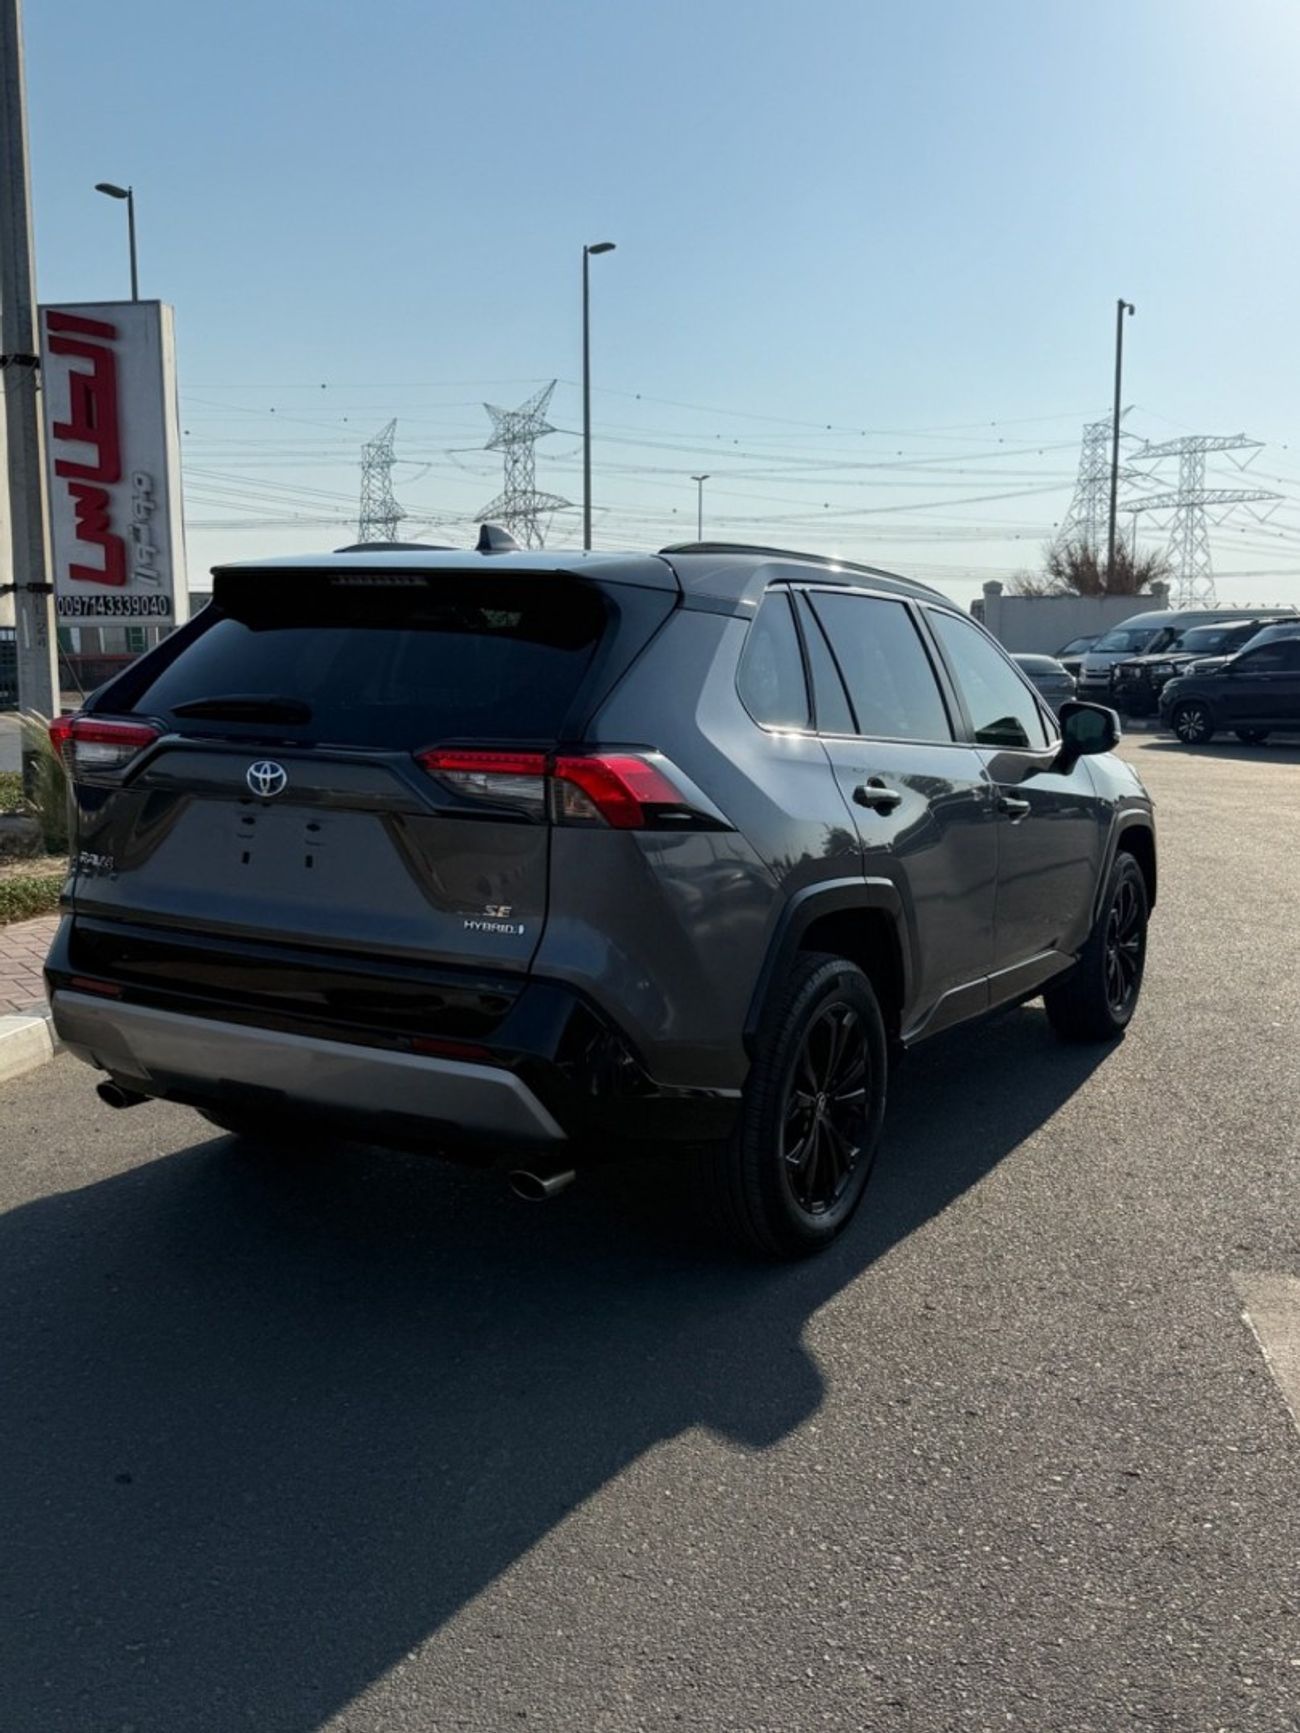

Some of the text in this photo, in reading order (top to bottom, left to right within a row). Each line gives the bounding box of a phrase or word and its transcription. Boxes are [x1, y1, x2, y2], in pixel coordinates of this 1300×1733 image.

[46, 309, 127, 587] الطاس
[57, 596, 168, 616] 0097143339040
[483, 904, 512, 917] SE
[463, 920, 514, 934] HYBRID
